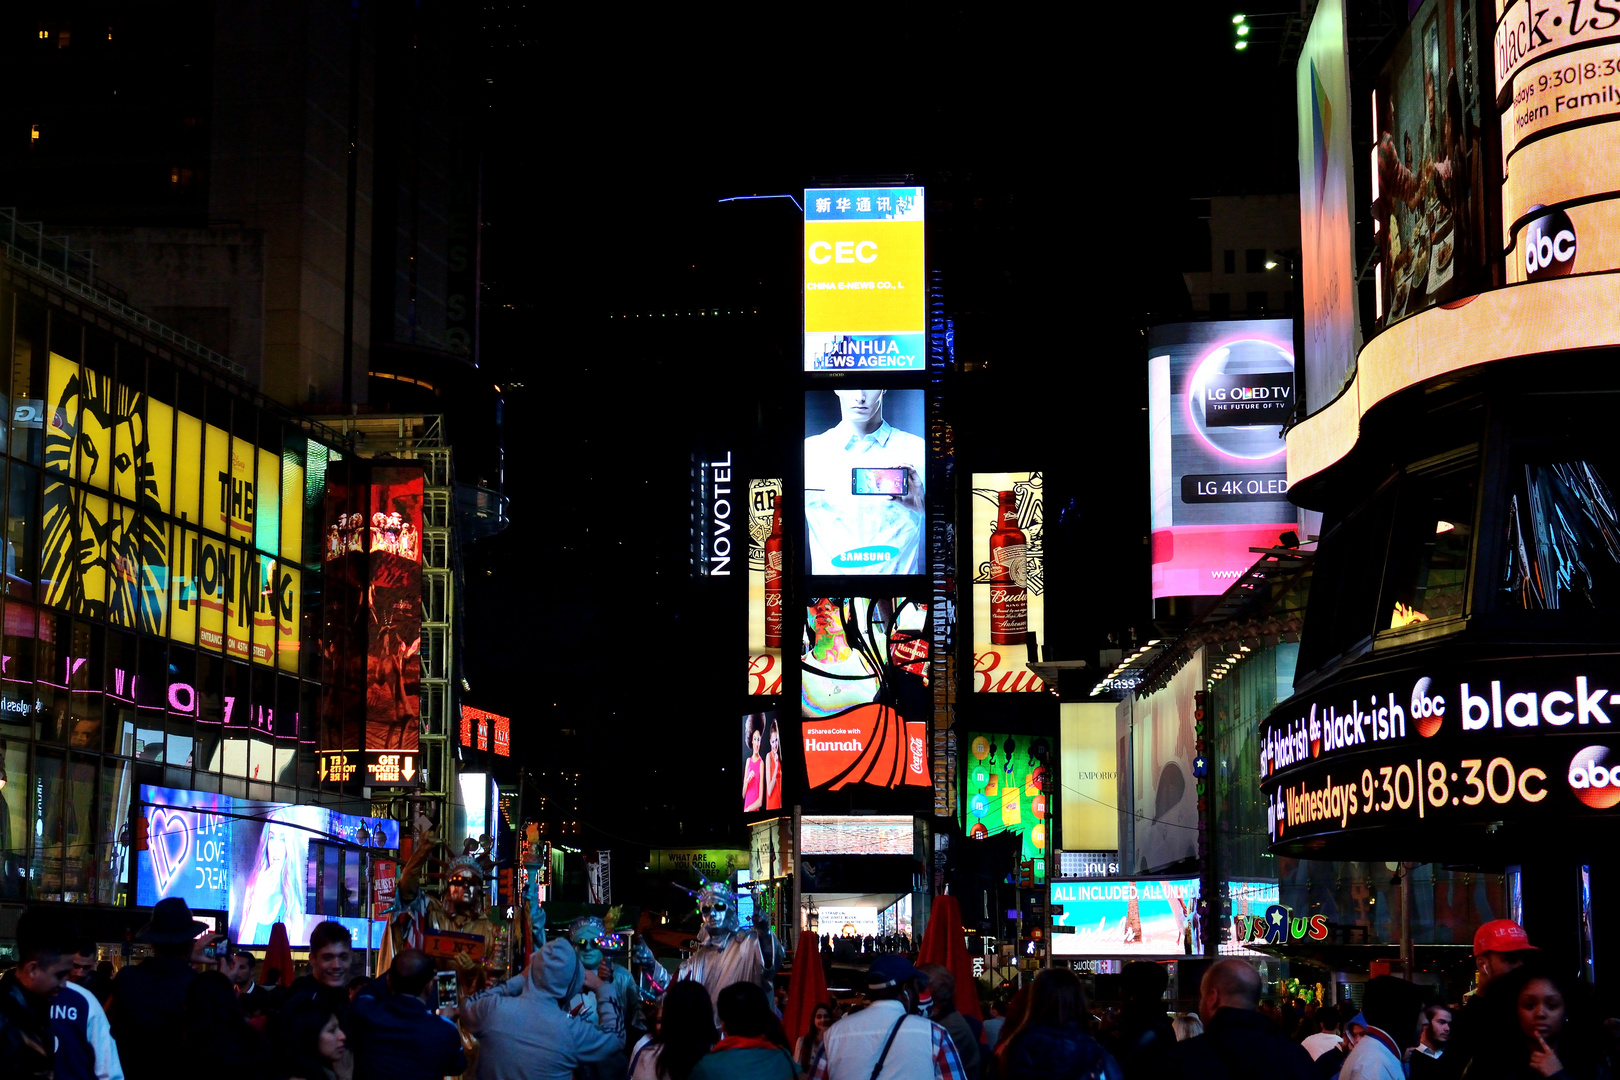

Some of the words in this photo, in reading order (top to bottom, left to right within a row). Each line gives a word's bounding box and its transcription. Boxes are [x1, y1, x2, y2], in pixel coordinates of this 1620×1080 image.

[808, 240, 878, 265] CEC
[1526, 227, 1576, 274] abc
[806, 282, 836, 290] CHINA
[838, 282, 875, 290] E-NEWS
[829, 340, 900, 355] XINHUA
[857, 354, 916, 367] AGENCY
[1208, 388, 1226, 401] LG
[1230, 387, 1270, 400] OLED
[1271, 386, 1290, 399] TV
[1198, 481, 1218, 496] LG
[1222, 480, 1243, 494] 4K
[1246, 480, 1289, 494] OLED
[218, 470, 253, 523] THE
[710, 450, 731, 576] NOVOTEL
[840, 552, 891, 562] SAMSUNG
[200, 630, 222, 646] ENTRANCE
[228, 637, 236, 649] ON
[237, 640, 248, 652] 45TH
[252, 644, 267, 658] STREET
[1274, 717, 1309, 770] black-ish
[1323, 692, 1406, 752] black-ish
[1410, 690, 1446, 719] abc
[806, 738, 864, 752] Hannah
[378, 754, 400, 765] GET
[367, 764, 400, 773] TICKETS
[1078, 771, 1117, 780] EMPORIO
[375, 772, 400, 782] HERE
[1286, 774, 1358, 829] Wednesdays
[668, 854, 690, 862] WHAT
[692, 854, 707, 862] ARE
[1054, 886, 1077, 901] ALL
[1078, 886, 1140, 900] INCLUDED.
[1142, 884, 1163, 900] ALL
[972, 956, 984, 978] tkts
[1074, 960, 1096, 970] swatch
